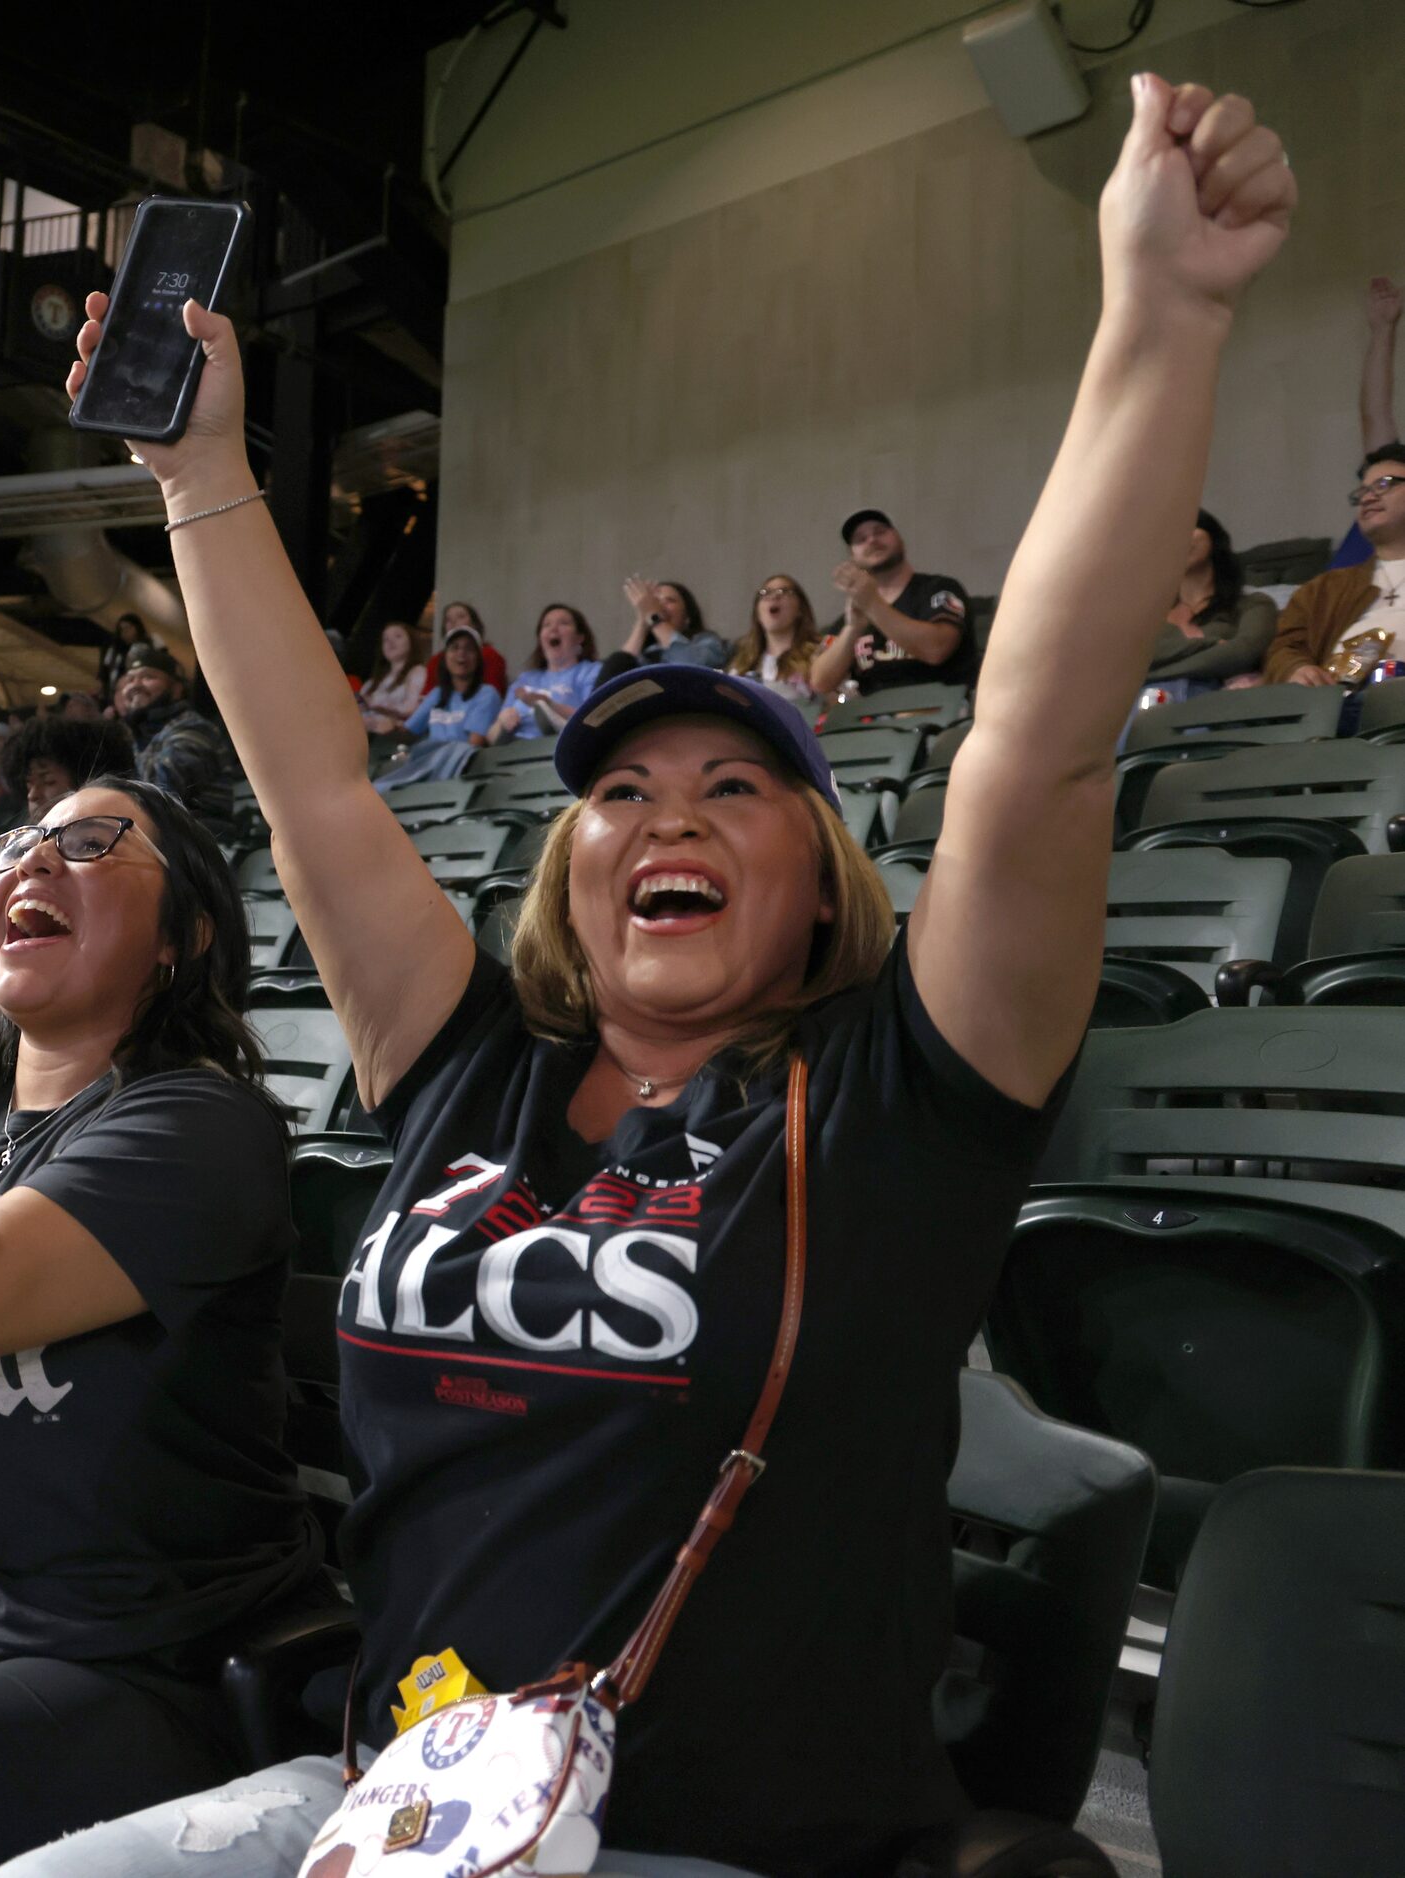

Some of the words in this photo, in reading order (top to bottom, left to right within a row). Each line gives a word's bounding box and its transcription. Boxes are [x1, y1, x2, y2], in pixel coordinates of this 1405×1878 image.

[156, 271, 190, 288] 7:30
[1152, 1211, 1164, 1225] 4
[337, 1211, 699, 1362] ALCS
[444, 1711, 476, 1747] T
